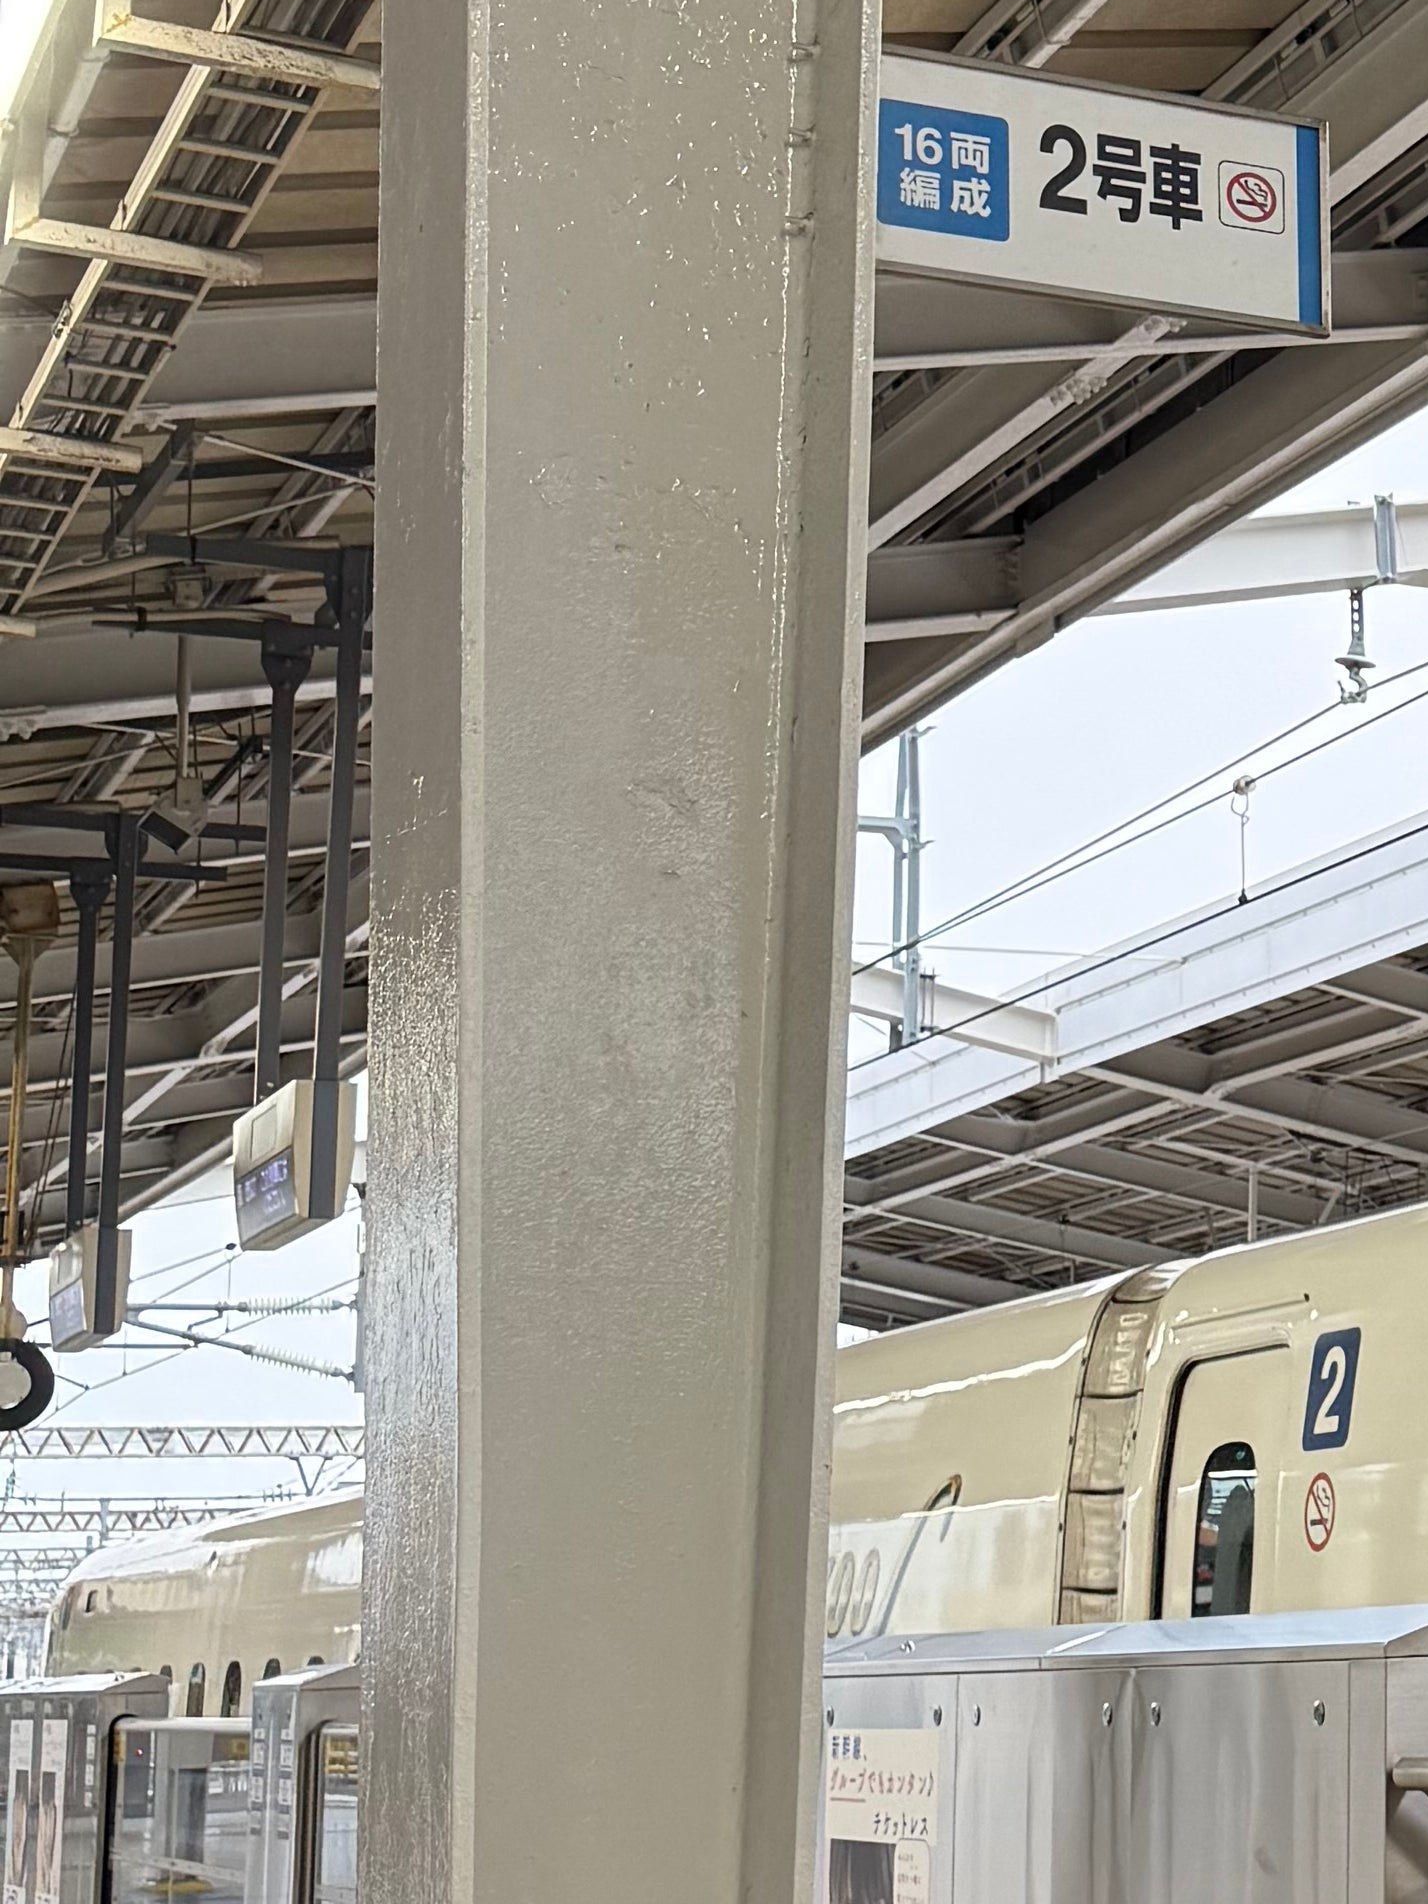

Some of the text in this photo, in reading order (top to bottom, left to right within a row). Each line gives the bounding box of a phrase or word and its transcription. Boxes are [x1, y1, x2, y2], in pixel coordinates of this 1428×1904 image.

[894, 122, 992, 176] 16両
[1039, 124, 1204, 231] 2号車
[899, 167, 992, 218] 編成
[1312, 1345, 1347, 1435] 2
